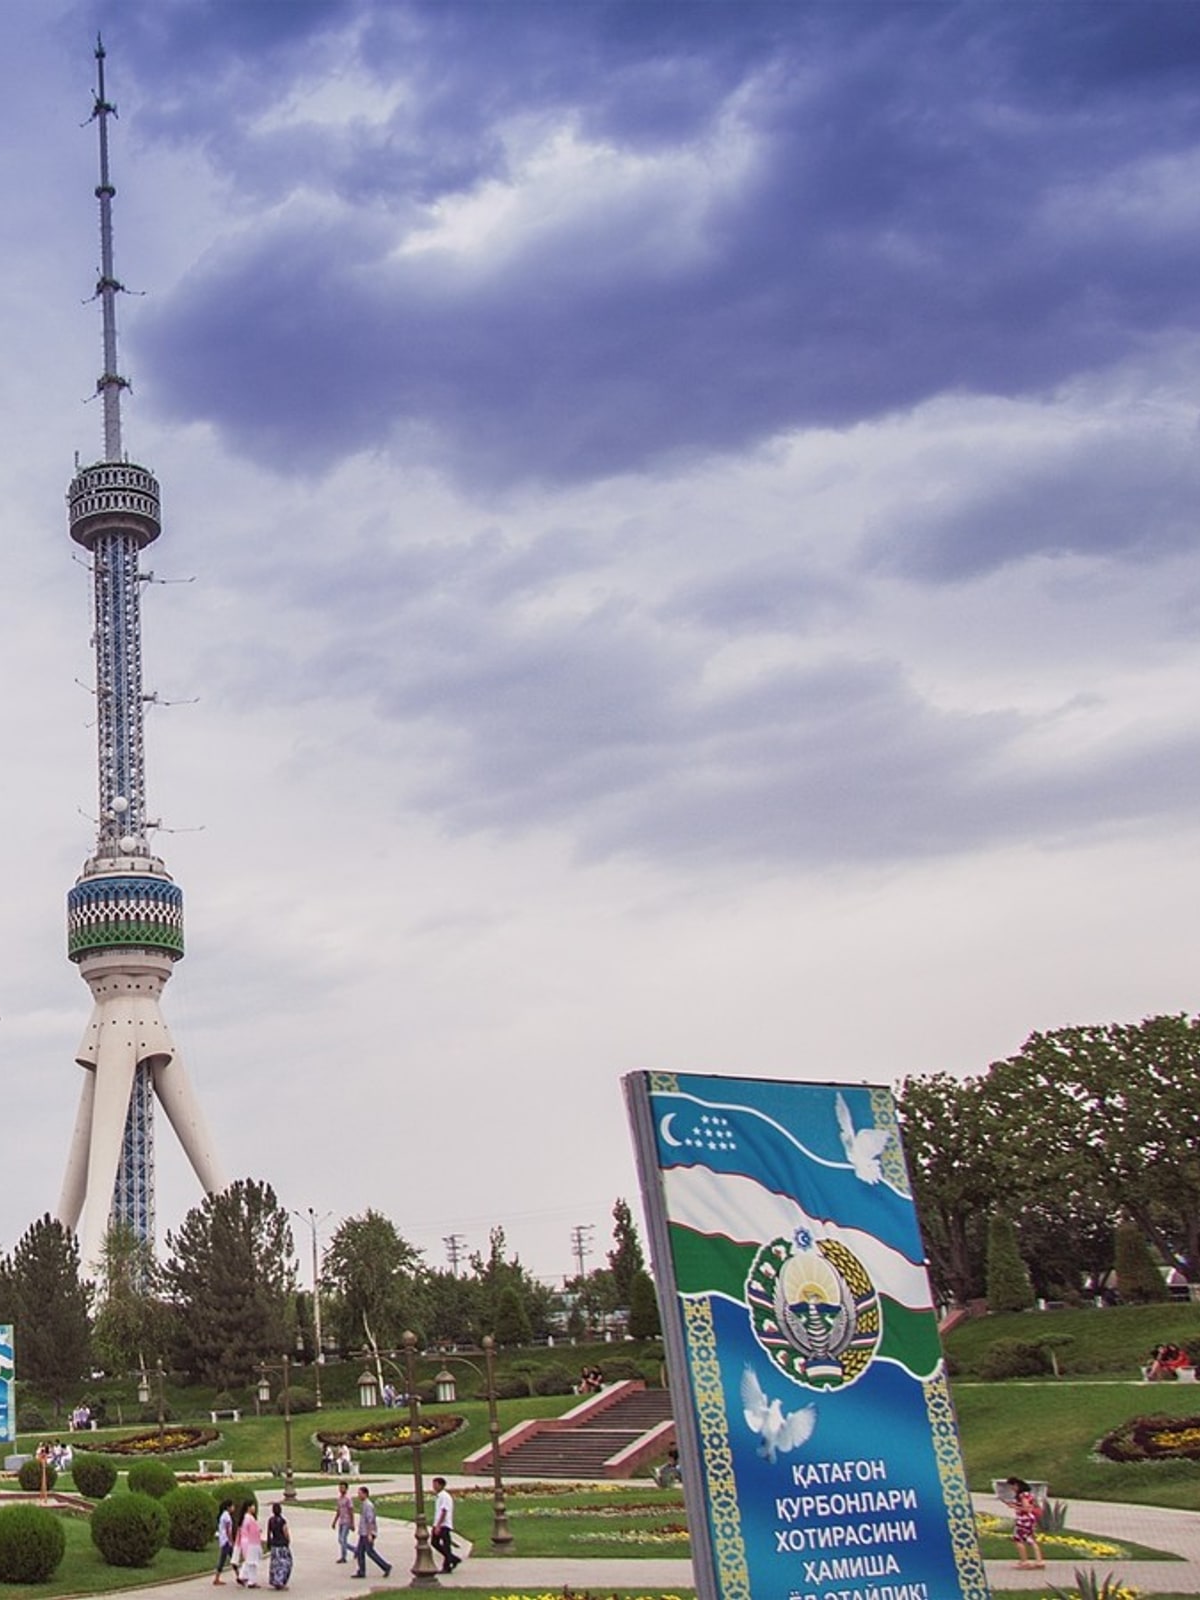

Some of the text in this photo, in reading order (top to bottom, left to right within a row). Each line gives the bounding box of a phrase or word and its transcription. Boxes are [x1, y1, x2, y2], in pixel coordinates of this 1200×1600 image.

[792, 1460, 886, 1489] ҚАТАҒОН
[775, 1489, 917, 1522] ҚУРБОНЛАРИ
[774, 1520, 917, 1551] ХОТИРАСИНИ
[803, 1553, 900, 1585] ҲАМИША
